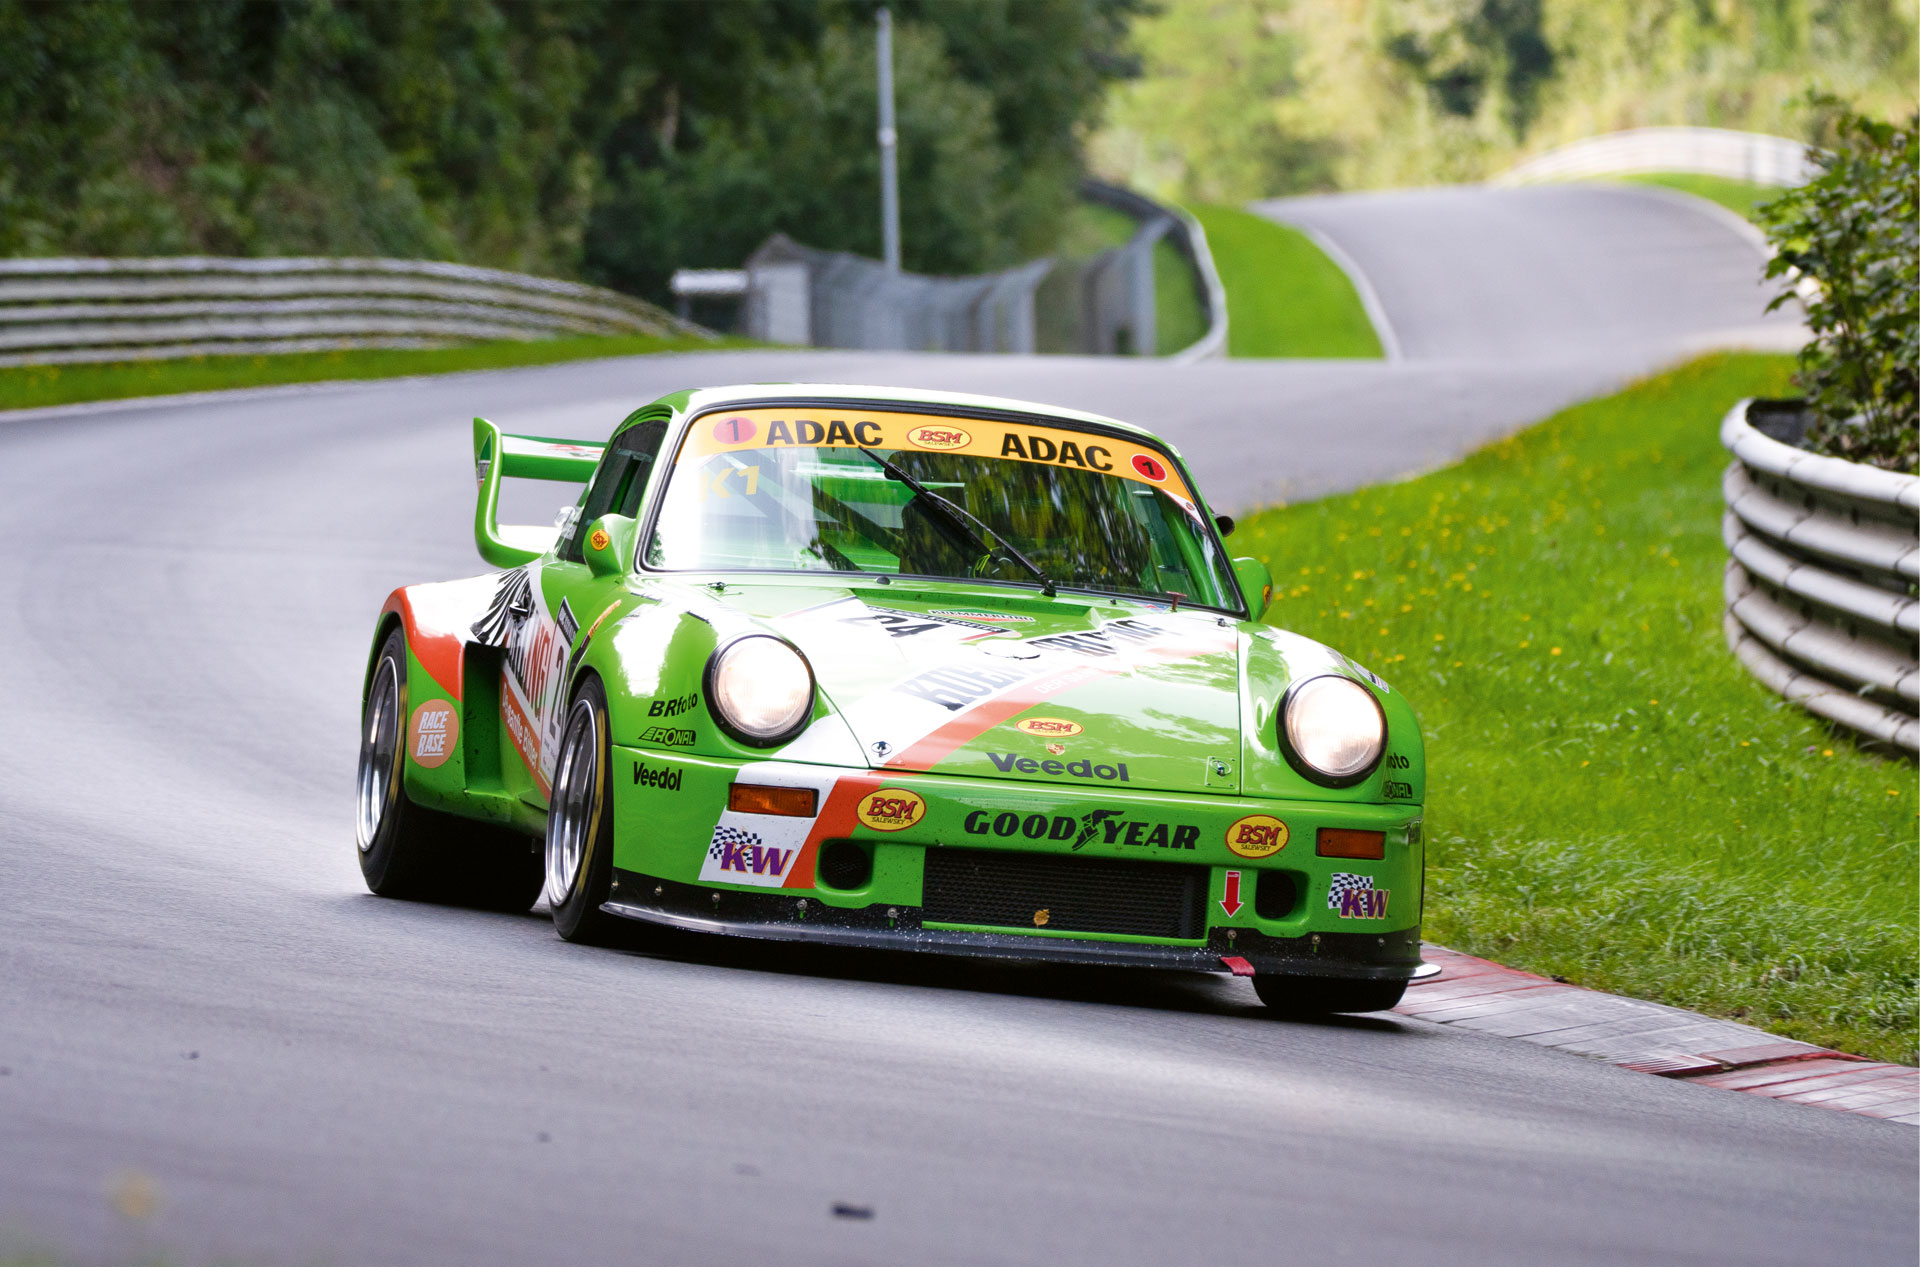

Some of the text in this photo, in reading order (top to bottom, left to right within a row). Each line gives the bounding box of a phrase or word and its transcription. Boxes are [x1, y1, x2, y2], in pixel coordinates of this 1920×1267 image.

[726, 419, 884, 446] 1 ADAC
[918, 430, 963, 444] BSM
[1000, 432, 1156, 476] ADAC 1
[648, 692, 698, 717] BRfoto
[418, 711, 450, 733] RACE
[1028, 721, 1073, 732] BSM
[417, 734, 447, 756] BASE
[652, 728, 696, 746] RONAL
[633, 761, 683, 791] Veedol
[986, 752, 1130, 782] Veedol
[867, 796, 918, 820] BSM
[1236, 824, 1283, 846] BSM
[720, 841, 794, 877] KW
[1339, 889, 1391, 919] KW
